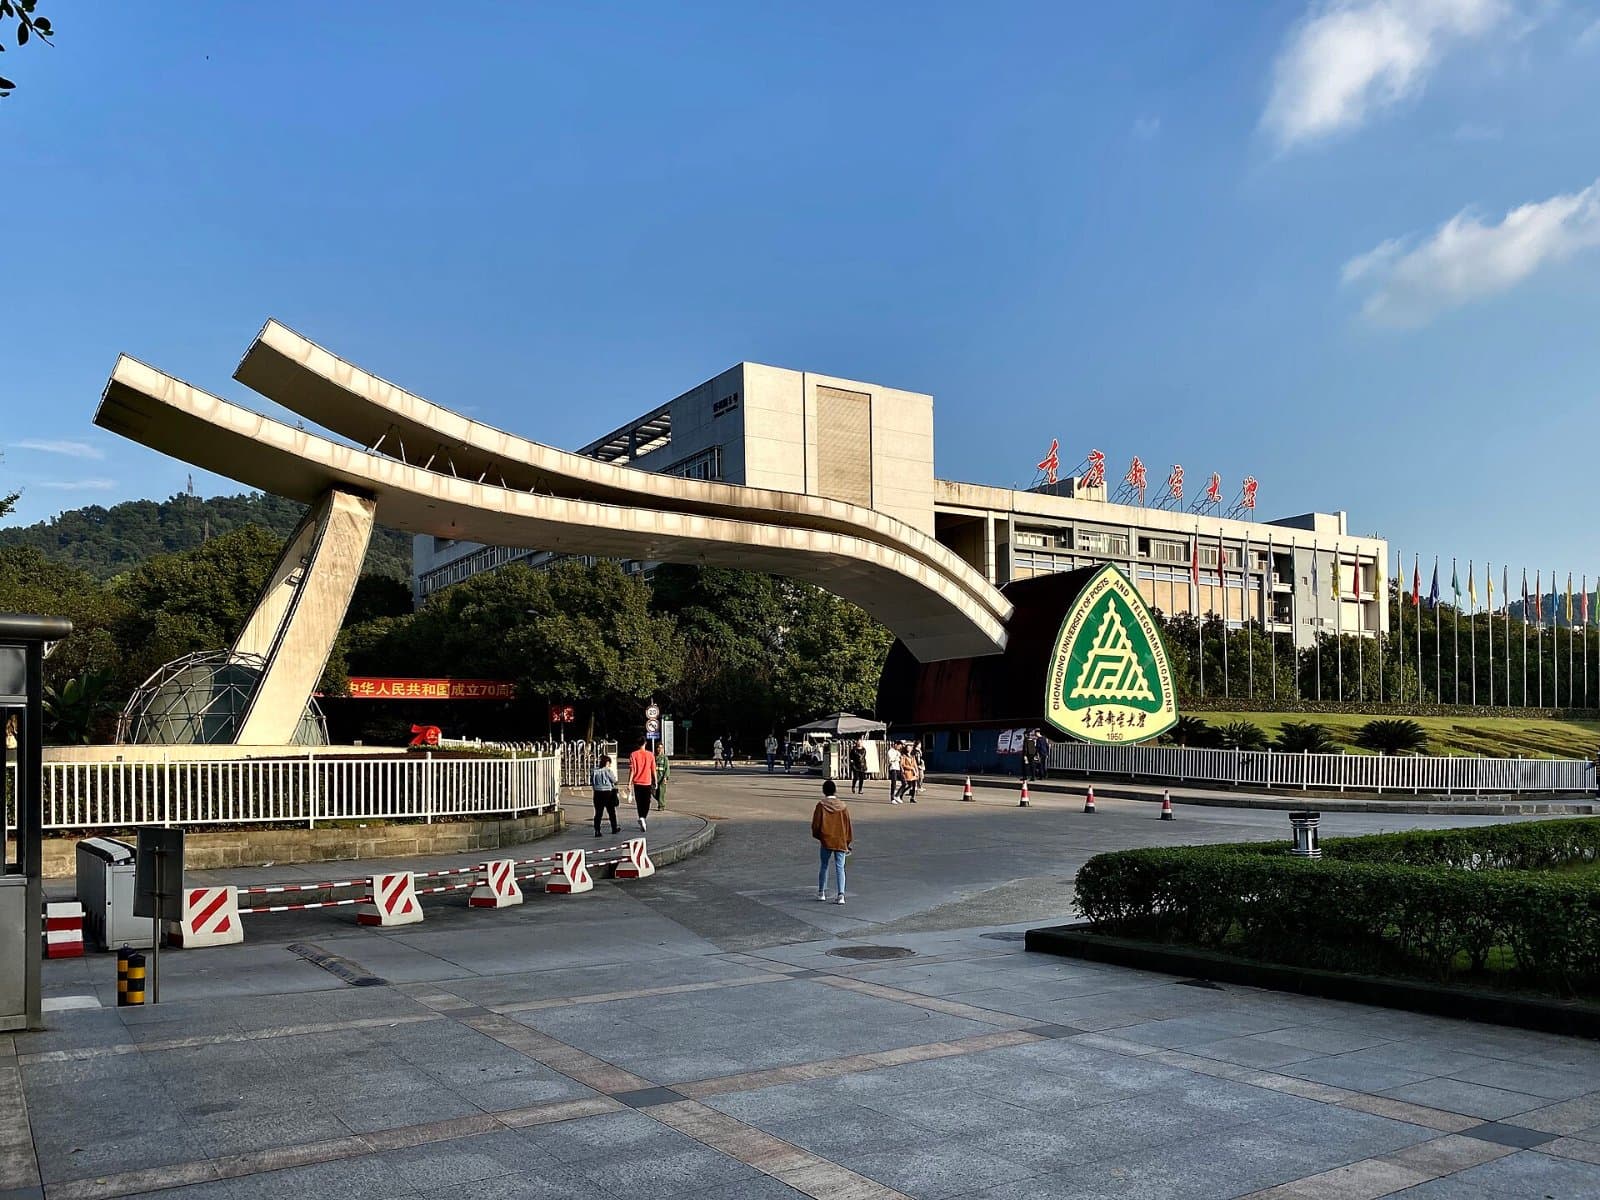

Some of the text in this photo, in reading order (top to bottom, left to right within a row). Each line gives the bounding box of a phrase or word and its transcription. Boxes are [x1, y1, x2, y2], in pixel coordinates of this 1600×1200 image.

[1053, 577, 1173, 713] CHONGQING UNIVERSITY OF POSTS AND TELECOMMUNICATIONS
[348, 681, 516, 697] 中华人民共和国成立70周
[1106, 732, 1124, 741] 1950
